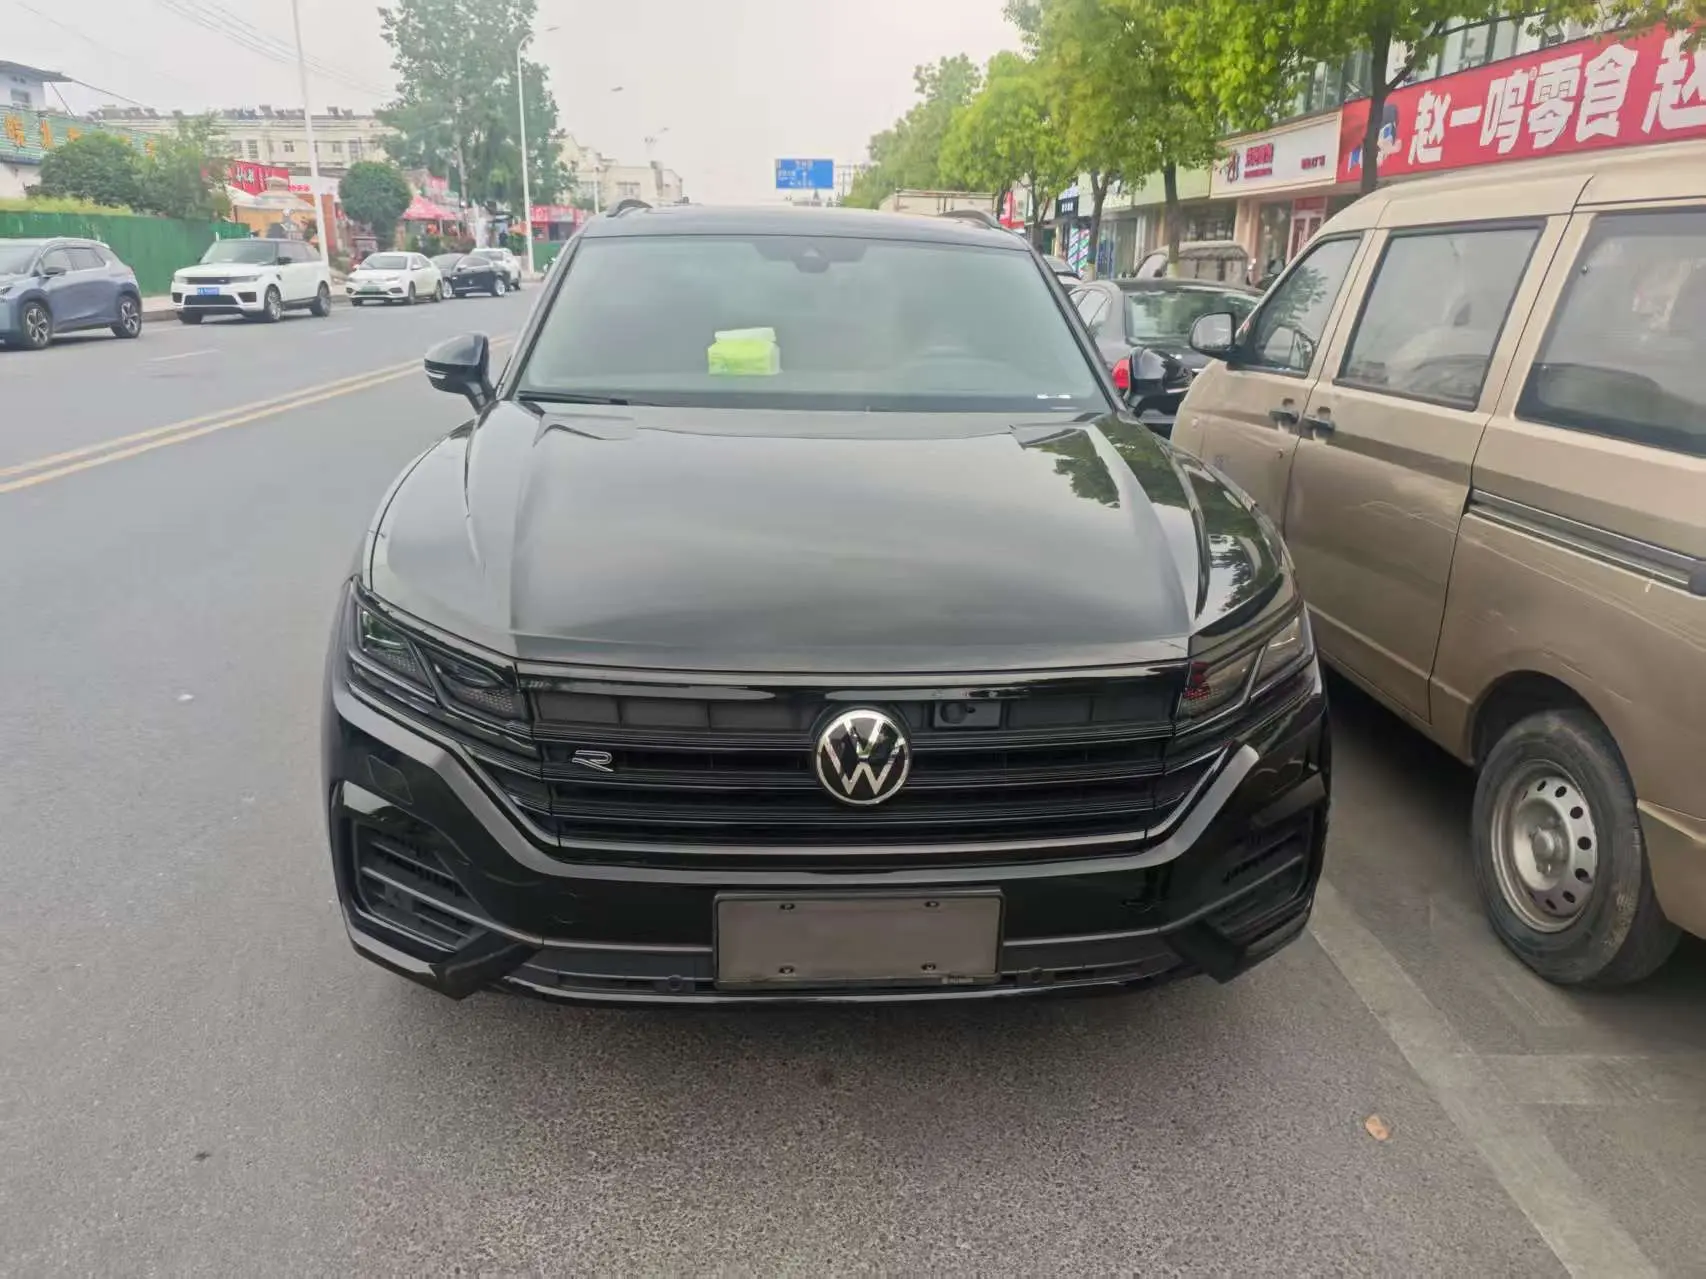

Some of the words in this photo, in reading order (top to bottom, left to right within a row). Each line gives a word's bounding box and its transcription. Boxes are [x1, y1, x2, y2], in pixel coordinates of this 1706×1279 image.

[1408, 43, 1639, 166] 赵一鸣零食
